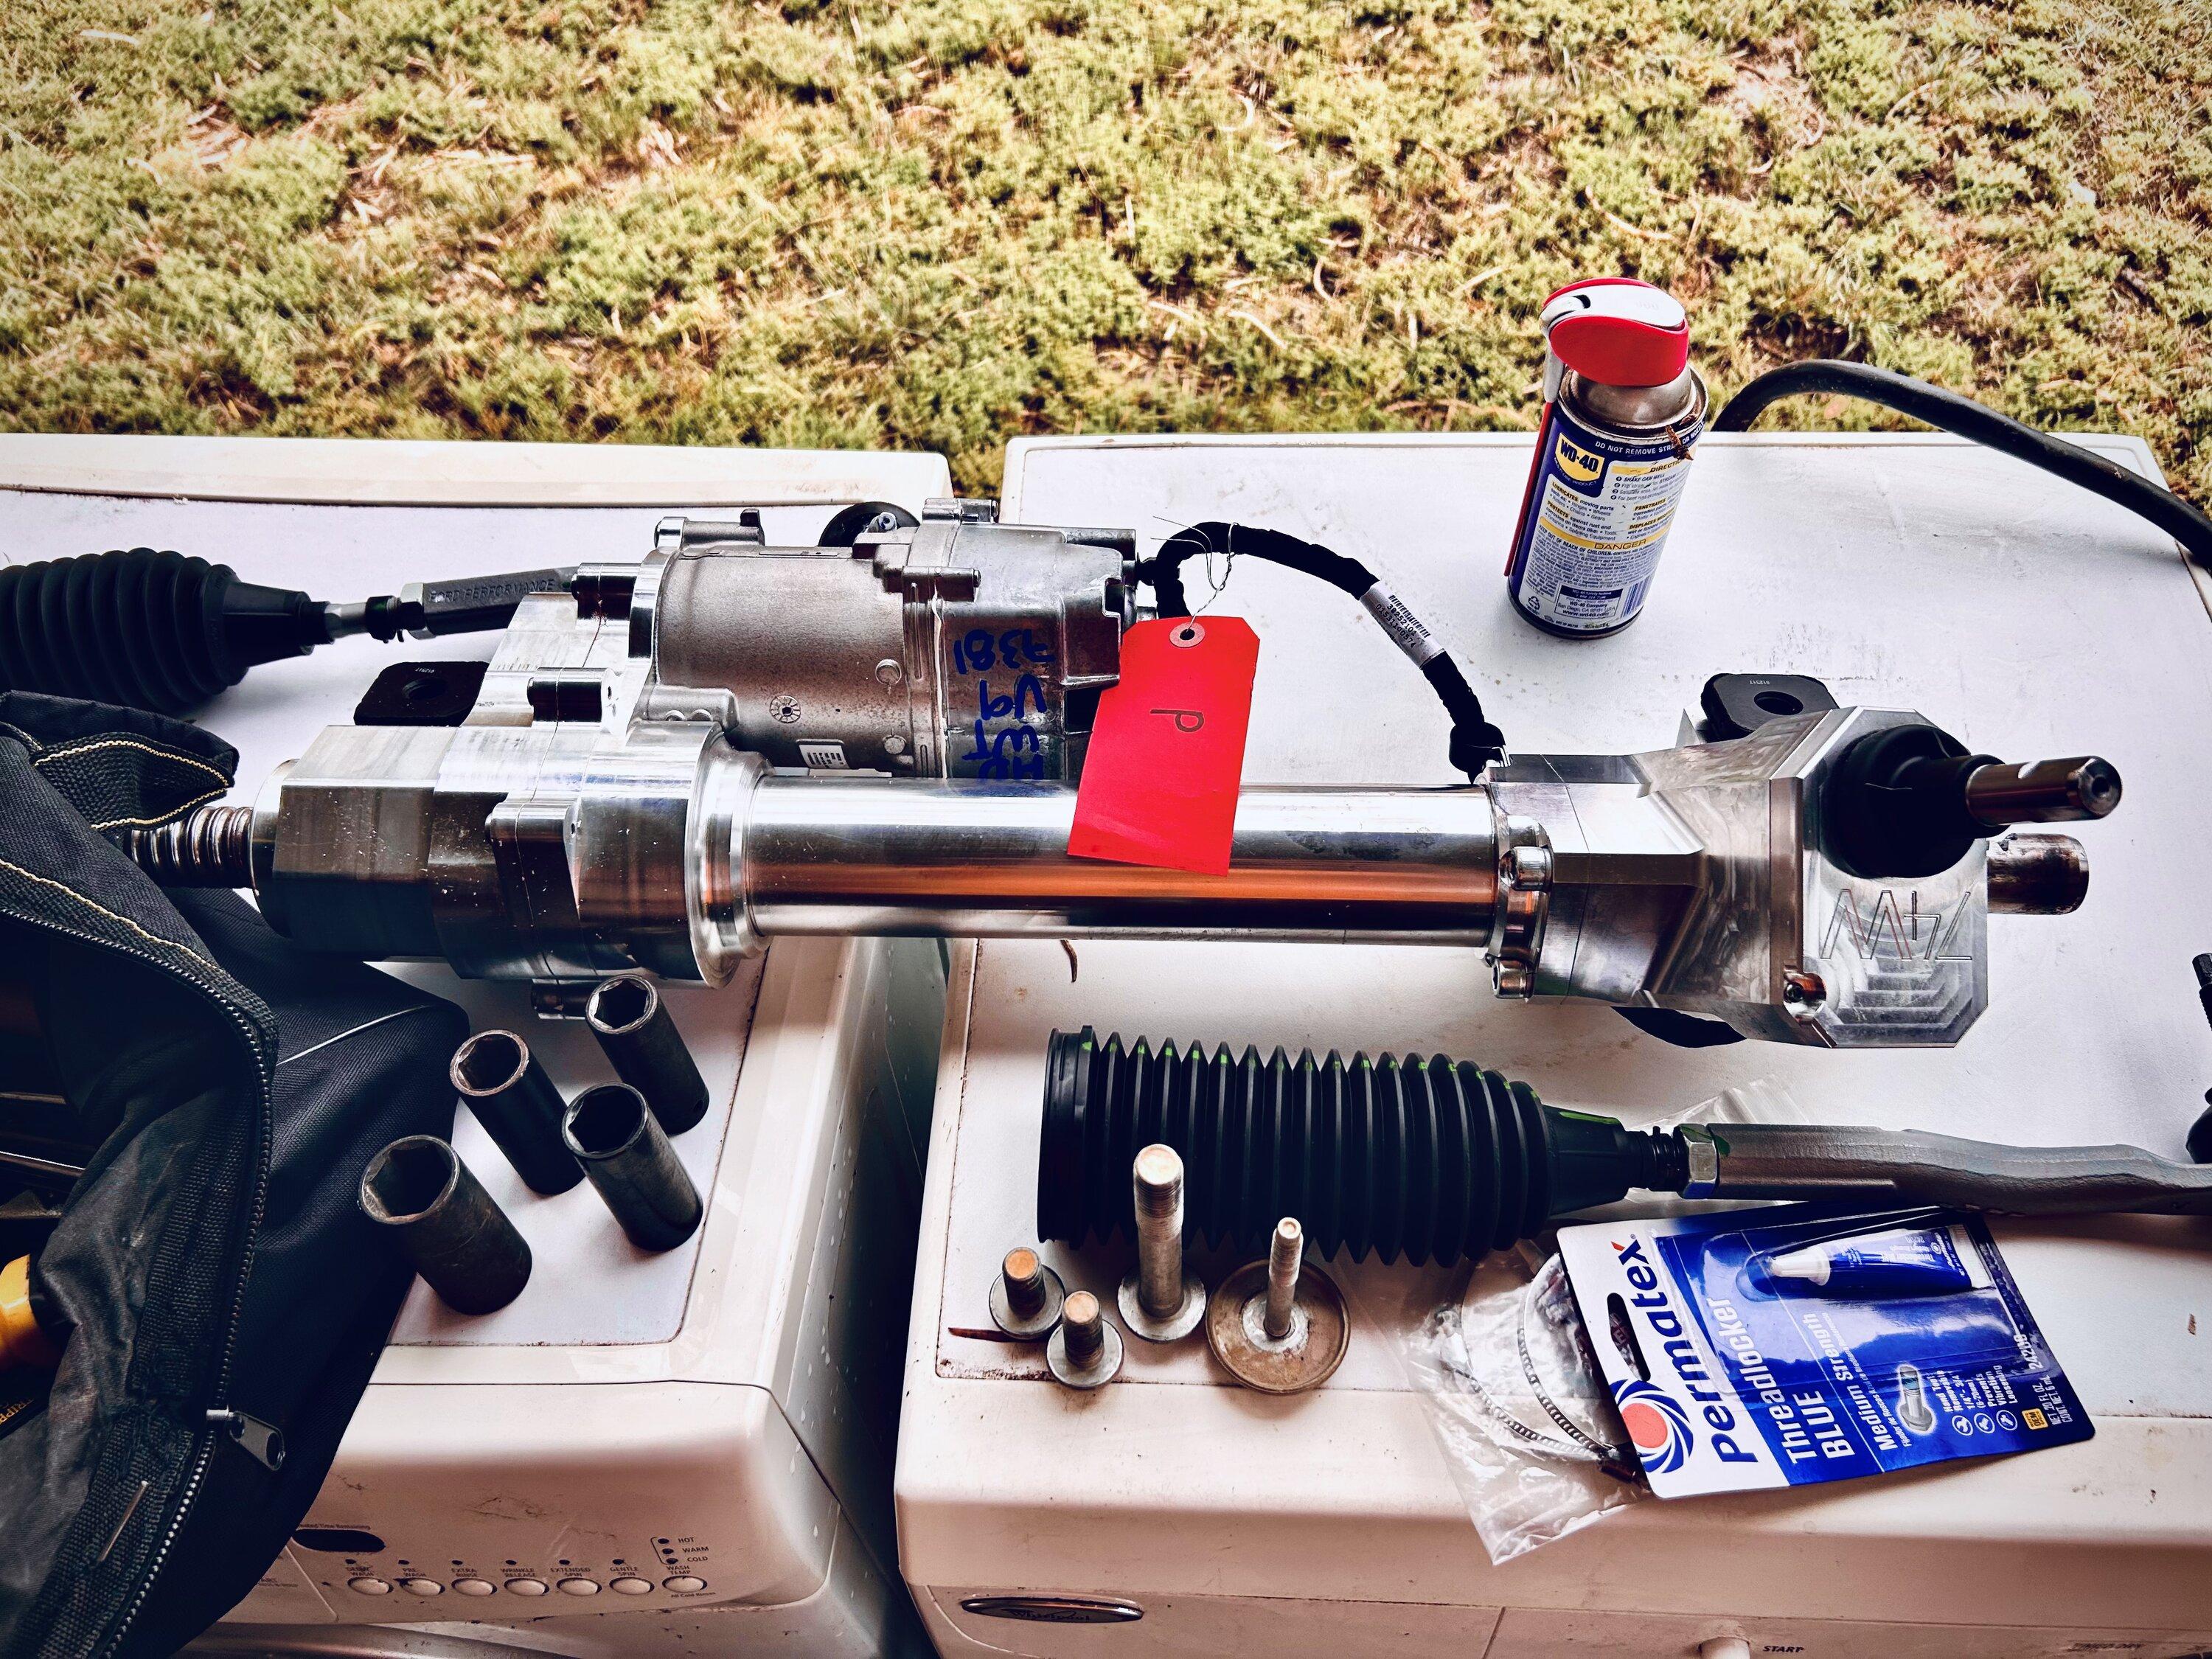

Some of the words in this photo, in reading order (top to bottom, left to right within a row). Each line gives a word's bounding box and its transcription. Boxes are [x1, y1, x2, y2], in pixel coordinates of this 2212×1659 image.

[1560, 438, 1599, 473] WD-40
[1595, 441, 1606, 449] DO
[1658, 445, 1677, 453] STRA
[1552, 481, 1578, 501] LUBRICATES
[1579, 499, 1599, 509] moving
[1547, 500, 1569, 518] PROTECTS
[1570, 516, 1588, 526] against
[1548, 532, 1556, 540] OUT
[1563, 540, 1578, 550] REACH
[1594, 539, 1646, 549] DANGER
[953, 629, 1056, 674] 7381
[1150, 708, 1206, 733] P
[1611, 1239, 1759, 1463] Permatex
[1803, 1313, 1854, 1381] Strength
[1705, 1297, 1818, 1465] Threadlocker
[1937, 1369, 1964, 1411] Removable
[1976, 1373, 1997, 1407] Prevents
[1986, 1371, 2008, 1406] Vibration
[1993, 1365, 2018, 1404] Loosening
[1847, 1385, 1899, 1451] Medium
[1935, 1392, 1954, 1413] Hand
[2048, 1412, 2062, 1425] NET
[1792, 1390, 1856, 1459] BLUE
[1888, 1416, 1897, 1425] de
[1762, 1645, 1804, 1654] START
